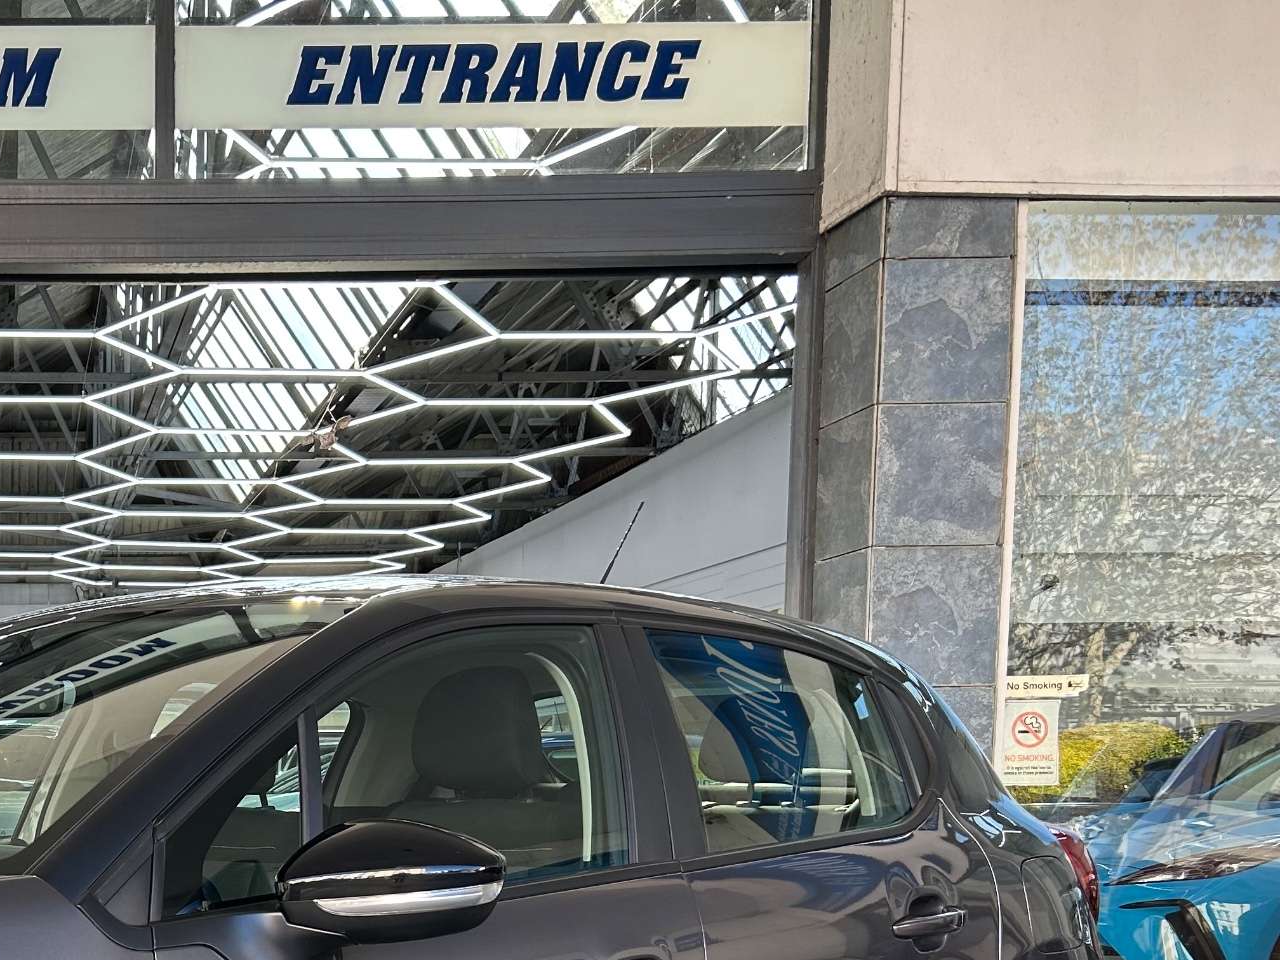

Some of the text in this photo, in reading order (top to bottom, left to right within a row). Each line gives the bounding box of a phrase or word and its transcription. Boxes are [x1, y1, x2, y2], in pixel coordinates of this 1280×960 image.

[286, 39, 703, 106] ENTRANCE
[1006, 681, 1063, 690] No Smoking
